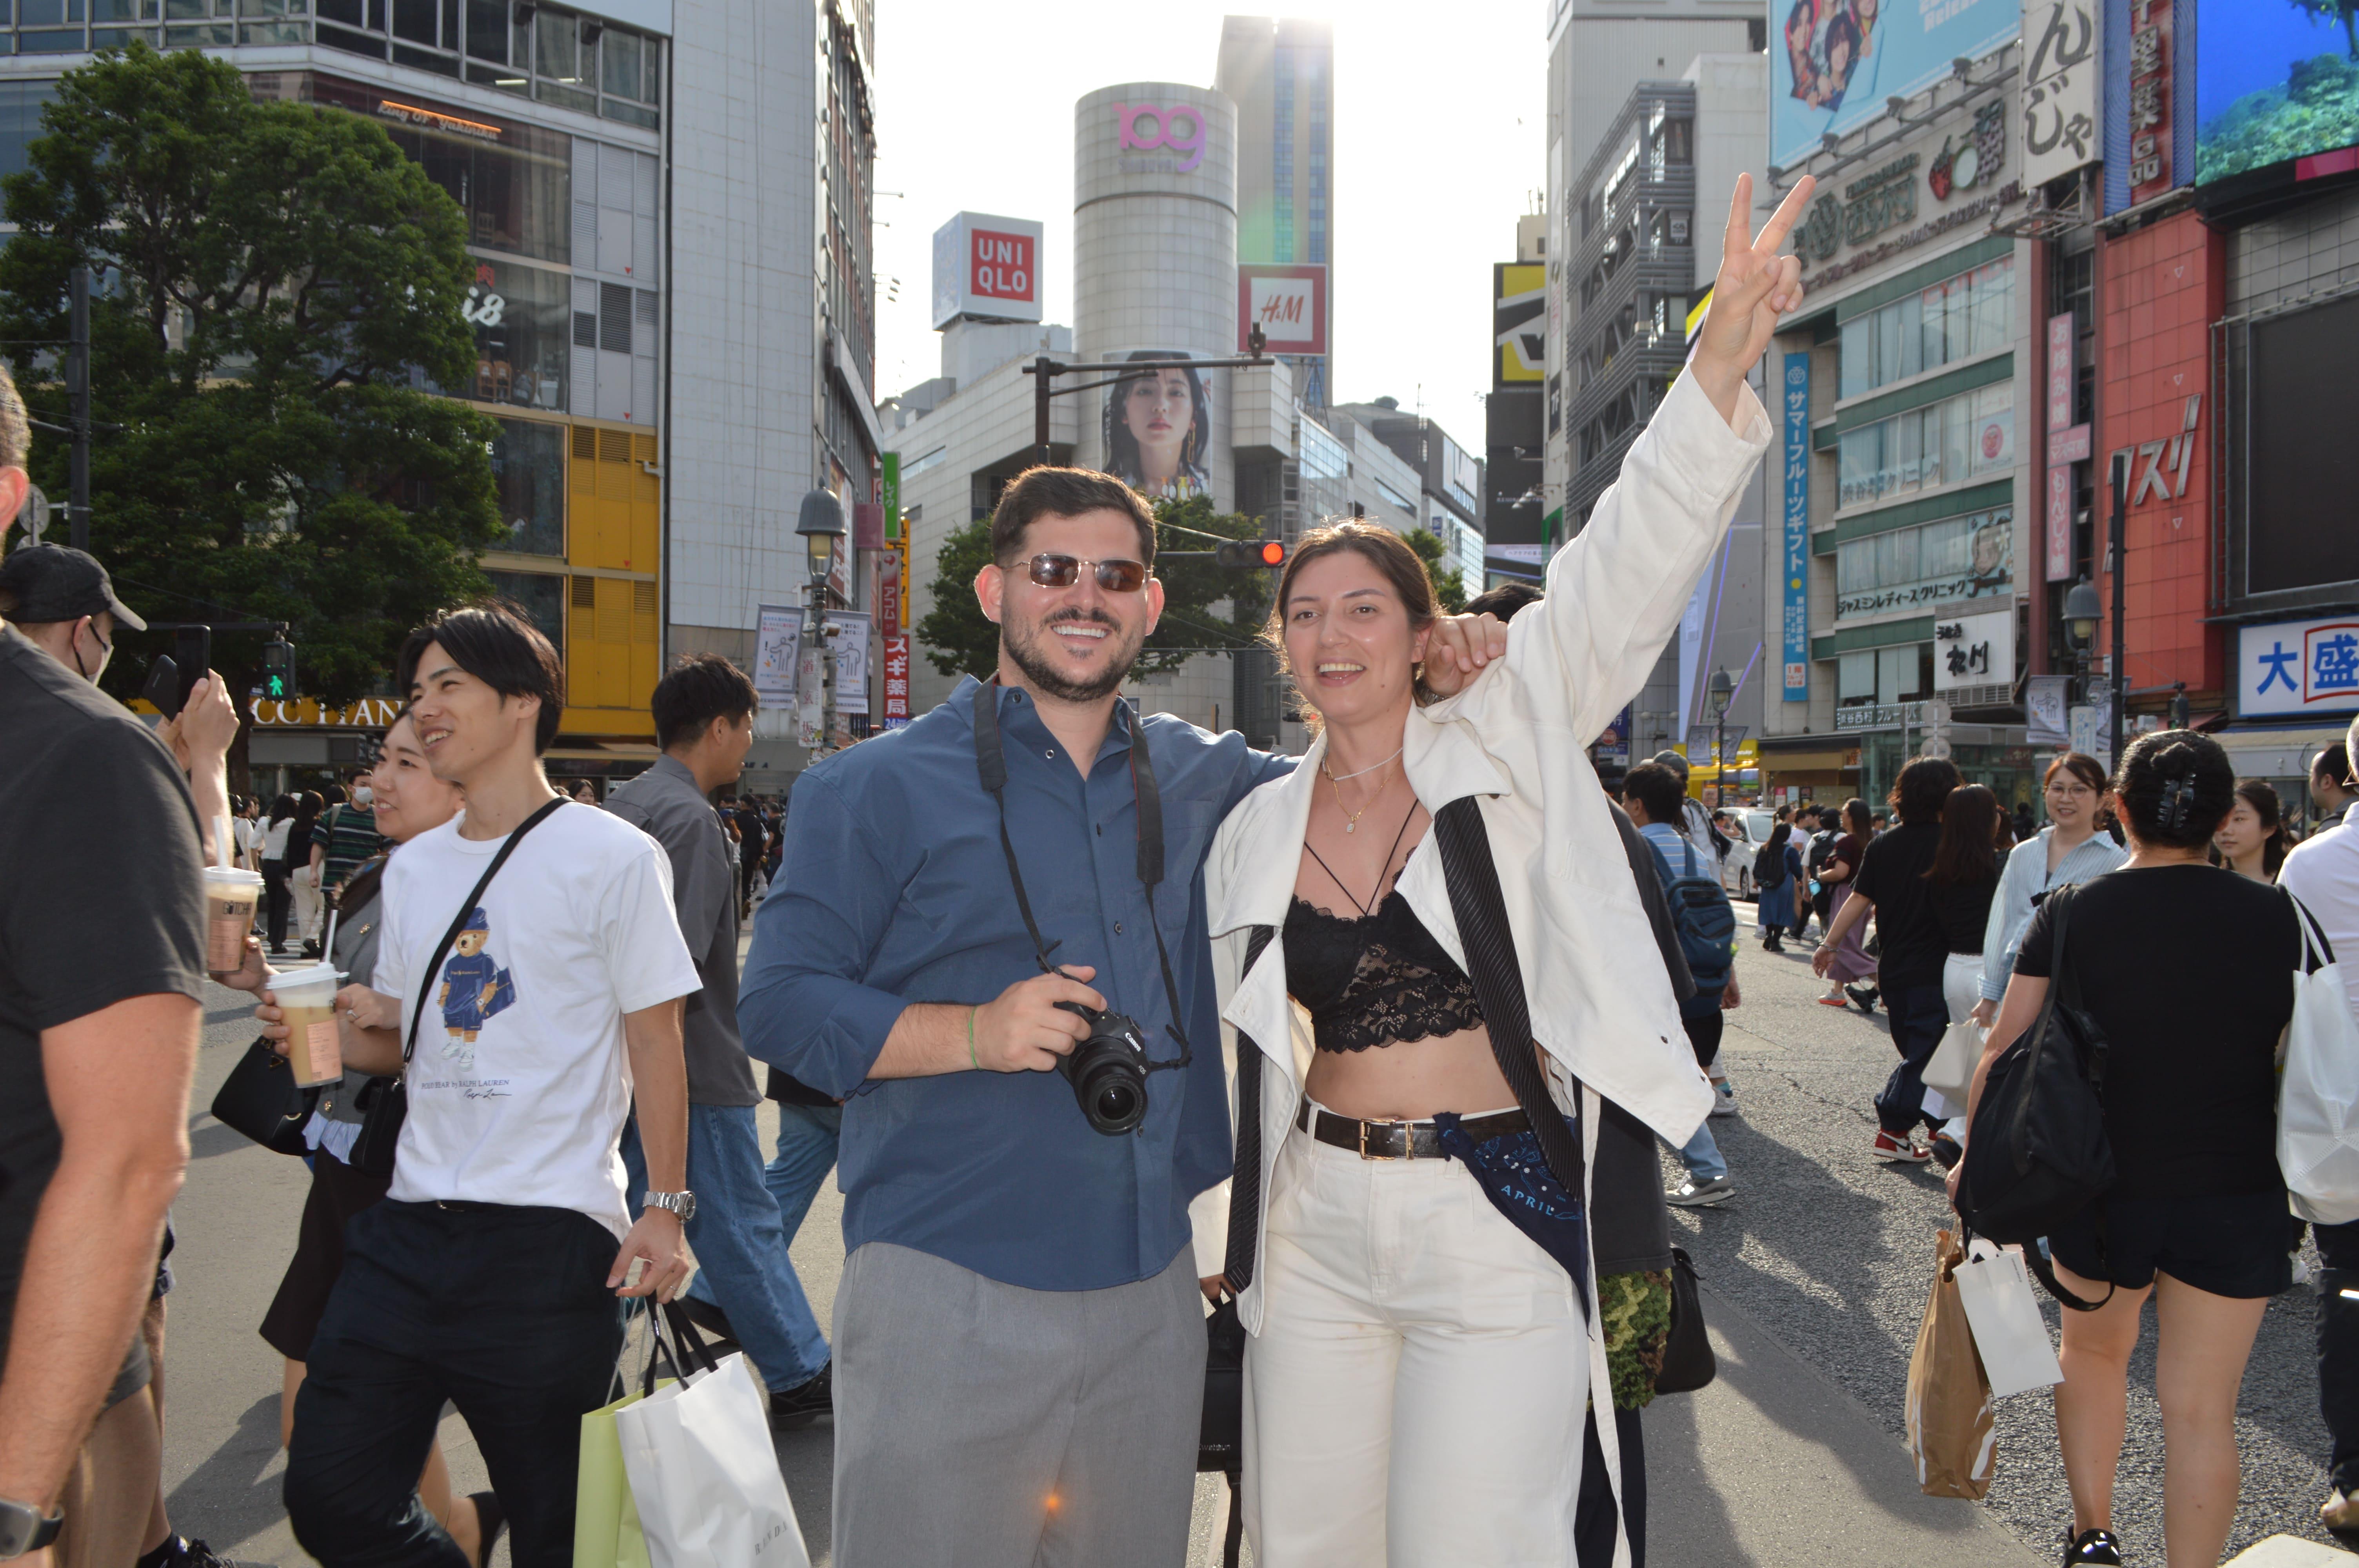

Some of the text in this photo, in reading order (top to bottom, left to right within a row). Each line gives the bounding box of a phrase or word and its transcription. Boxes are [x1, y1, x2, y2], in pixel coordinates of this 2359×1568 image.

[1112, 102, 1206, 172] 109
[978, 238, 1022, 266] UNI
[978, 266, 1027, 293] QLO
[1260, 294, 1305, 323] H&M
[2052, 323, 2068, 424] お好み焼
[885, 481, 894, 508] レイク
[1787, 390, 1805, 572] サマーフルーツギフト
[2050, 473, 2066, 575] もんじゃ焼
[884, 586, 895, 620] アコム
[1839, 579, 1966, 614] ジャスミンレディースクリニック
[1946, 640, 1988, 677] 松川
[2256, 633, 2359, 695] 大盛
[887, 638, 908, 715] スギ薬局
[1125, 1032, 1141, 1052] Canon
[1138, 1065, 1147, 1074] EOS
[1501, 1185, 1553, 1216] APRIL
